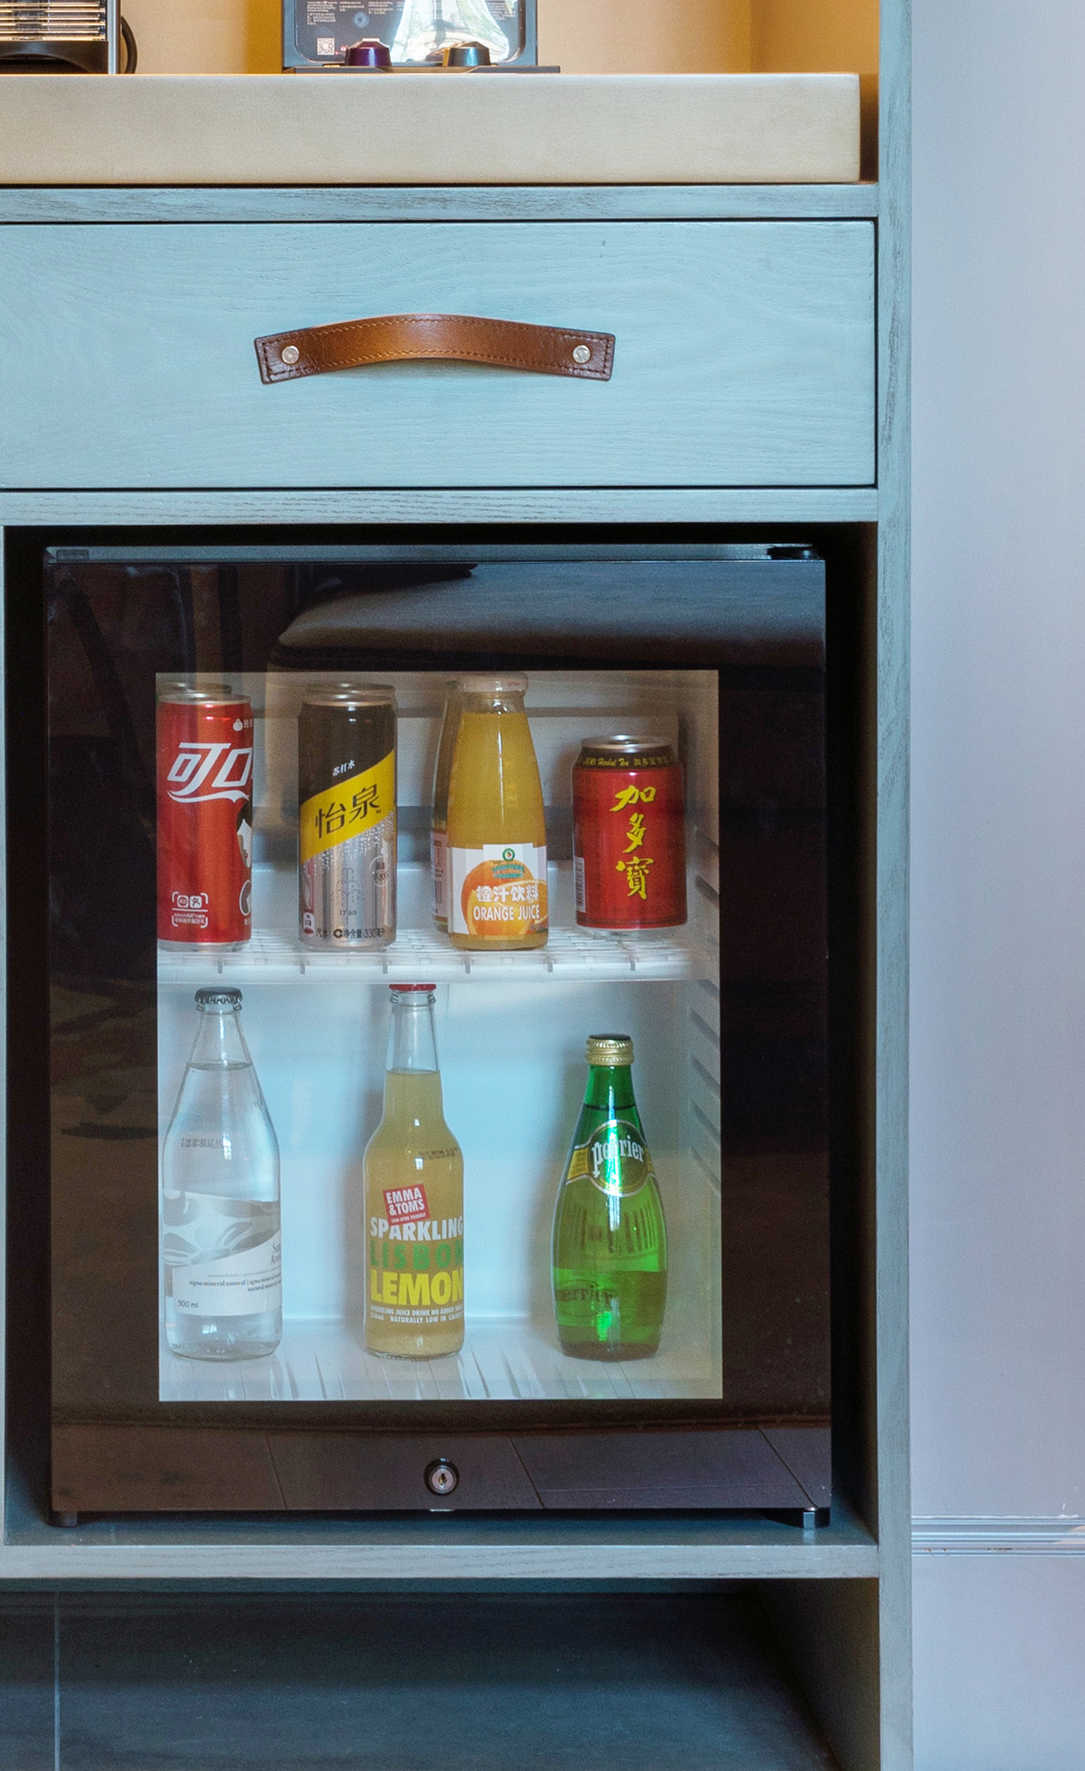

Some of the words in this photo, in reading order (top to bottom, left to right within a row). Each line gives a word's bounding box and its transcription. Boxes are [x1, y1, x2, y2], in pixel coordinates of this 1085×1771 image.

[315, 783, 380, 839] 怡泉
[476, 884, 539, 903] 橙汁饮料
[473, 906, 514, 921] ORANGE
[517, 904, 540, 920] JUICE
[385, 1187, 423, 1204] EMMA
[370, 1215, 463, 1241] SPARKLING
[370, 1268, 463, 1306] LEMON
[178, 1300, 190, 1308] 500
[390, 1315, 423, 1324] NATURALLY
[426, 1315, 438, 1323] LOW
